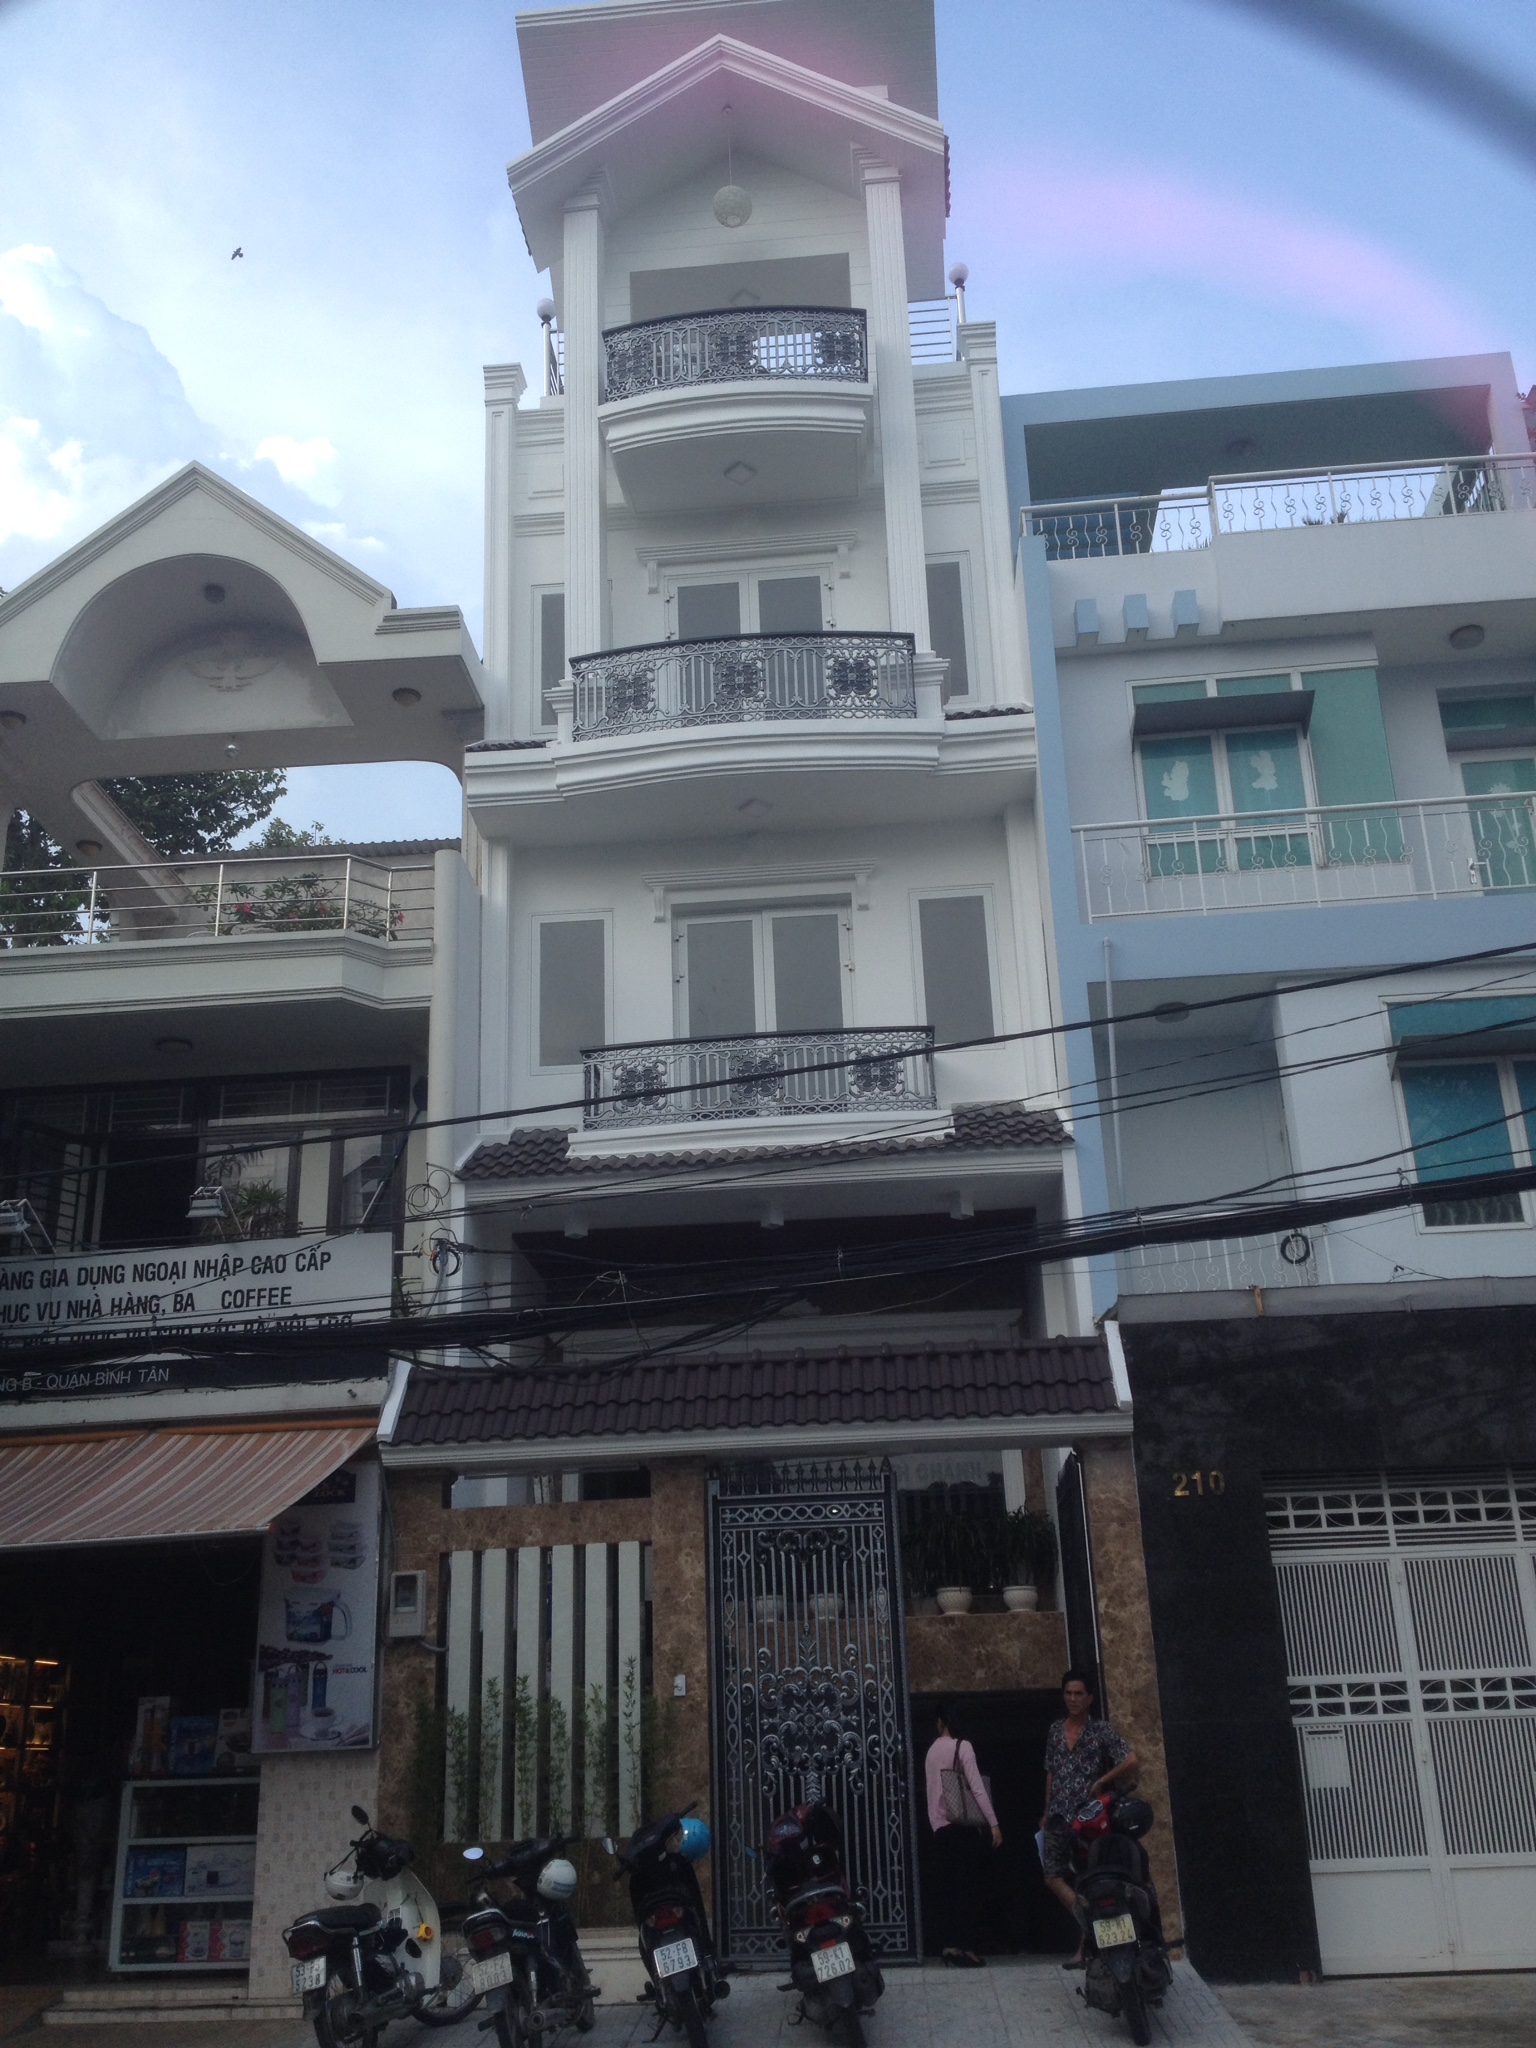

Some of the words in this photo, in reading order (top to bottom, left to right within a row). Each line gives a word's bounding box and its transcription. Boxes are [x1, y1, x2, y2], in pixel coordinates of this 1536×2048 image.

[40, 1268, 69, 1289] GIA
[77, 1265, 125, 1290] DỤNG
[132, 1261, 187, 1285] NGOẠI
[193, 1253, 244, 1281] NHẬP
[251, 1254, 287, 1275] CAO
[295, 1245, 331, 1272] CẤP
[37, 1301, 61, 1324] VỤ
[67, 1293, 102, 1319] NHÀ
[173, 1292, 195, 1312] BA
[221, 1286, 292, 1310] COFFEE
[95, 1368, 131, 1386] BÌNH
[138, 1366, 170, 1382] TÂN
[1172, 1471, 1225, 1496] 210
[660, 1942, 688, 1961] 52-F8
[817, 1946, 844, 1965] 59-K1
[663, 1954, 691, 1974] 6793
